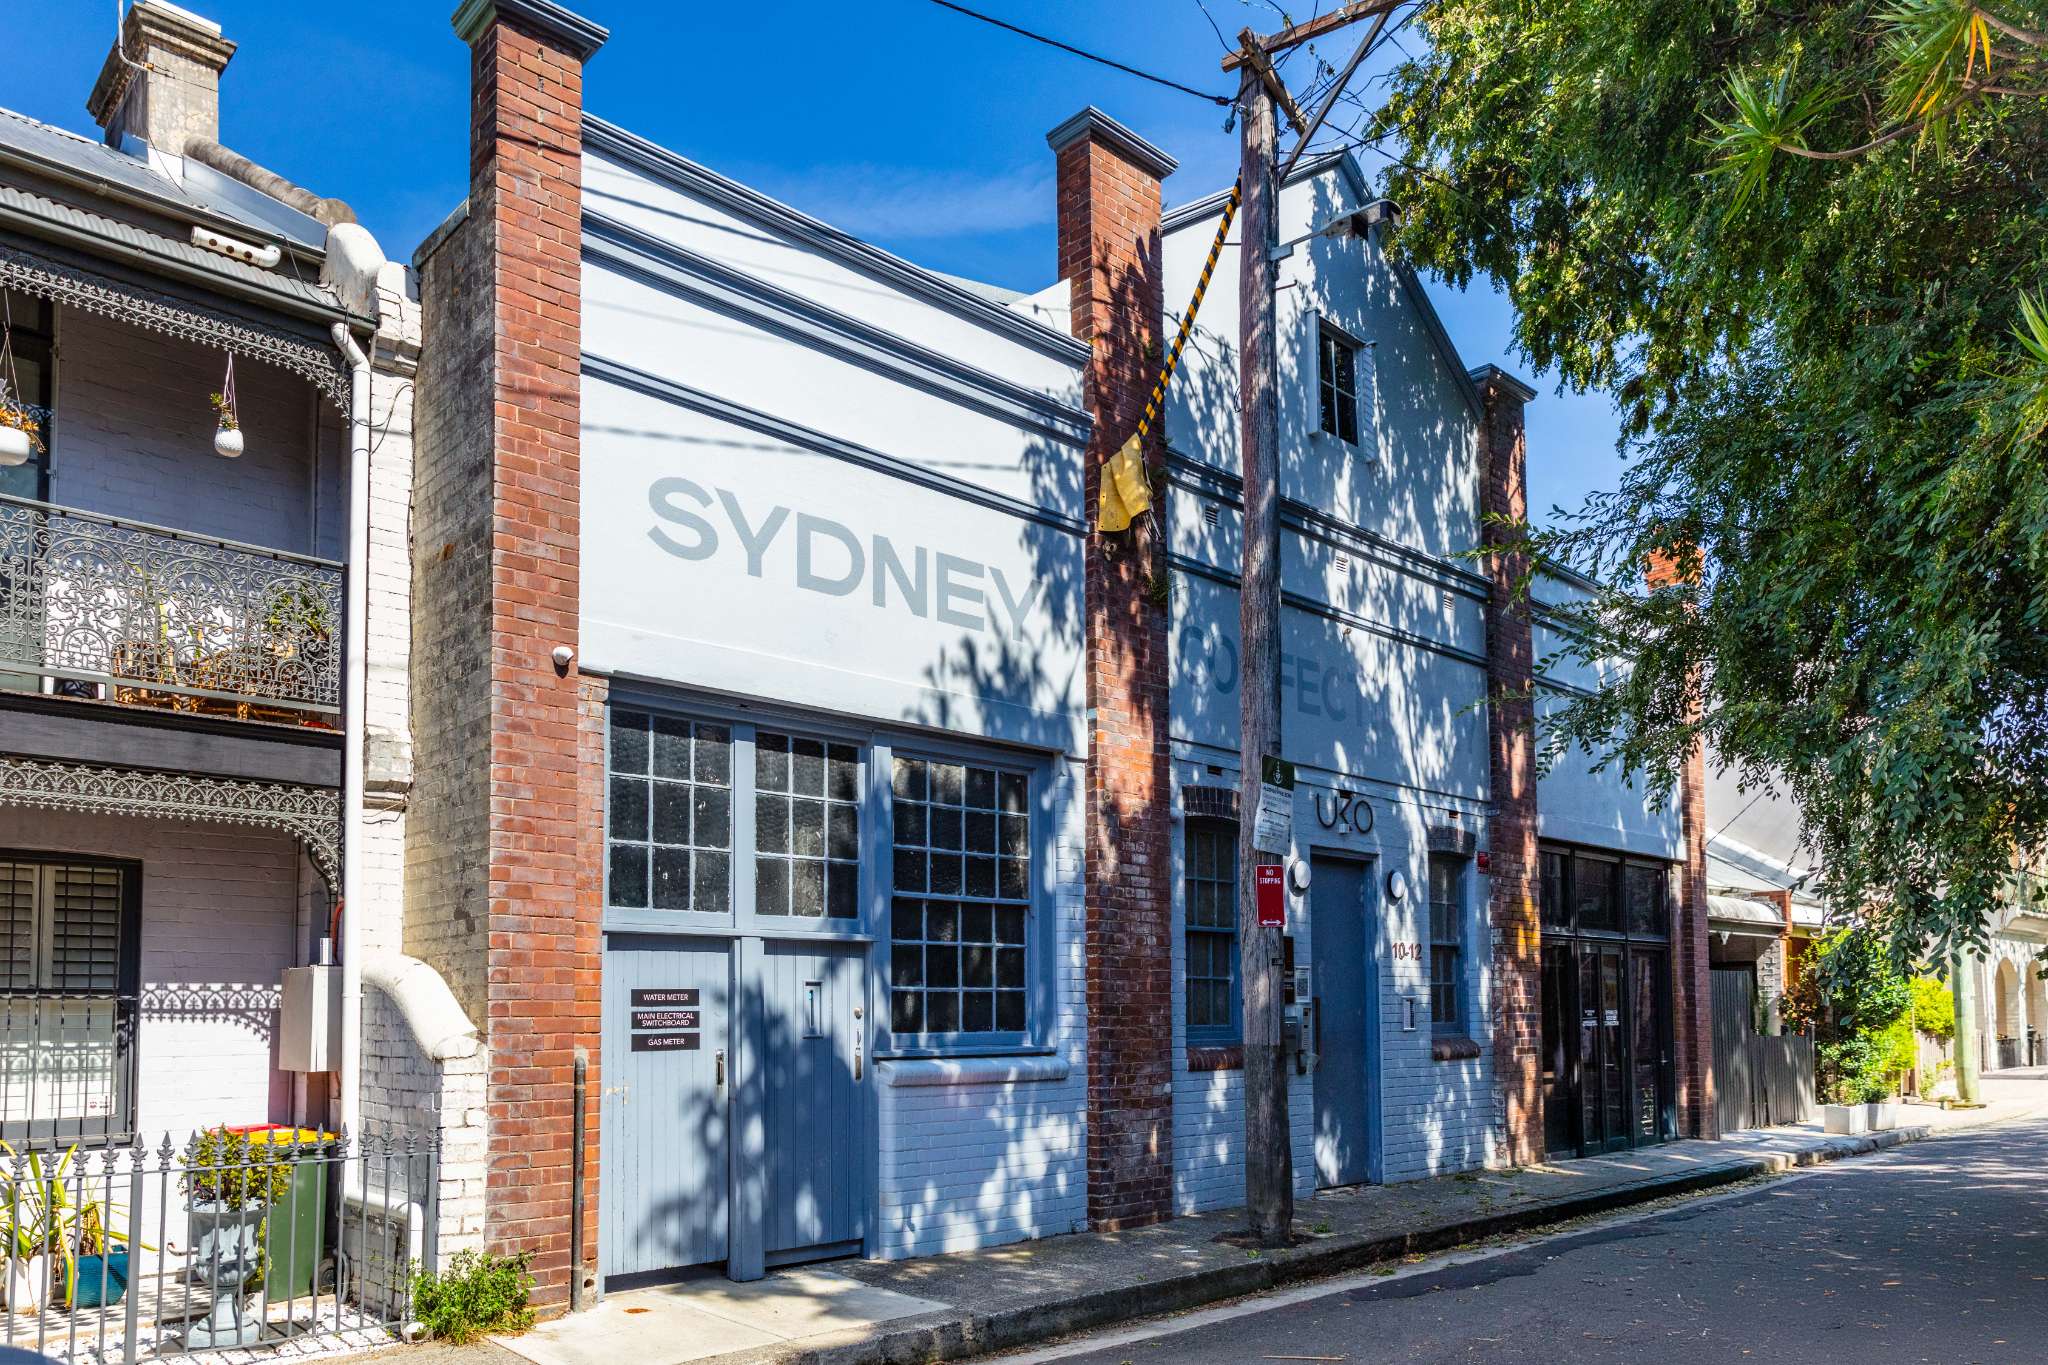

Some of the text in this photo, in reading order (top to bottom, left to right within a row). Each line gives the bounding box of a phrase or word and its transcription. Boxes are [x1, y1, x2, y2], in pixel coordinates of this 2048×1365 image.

[647, 476, 1046, 642] SYDNEY
[1265, 868, 1275, 876] NO
[1259, 877, 1281, 885] STOPPING
[1392, 942, 1422, 961] 10-12
[643, 993, 689, 1001] WATER METER
[656, 1012, 694, 1020] ELECTRICAL
[642, 1019, 690, 1027] SWITCHBOARD
[648, 1038, 662, 1046] GAS
